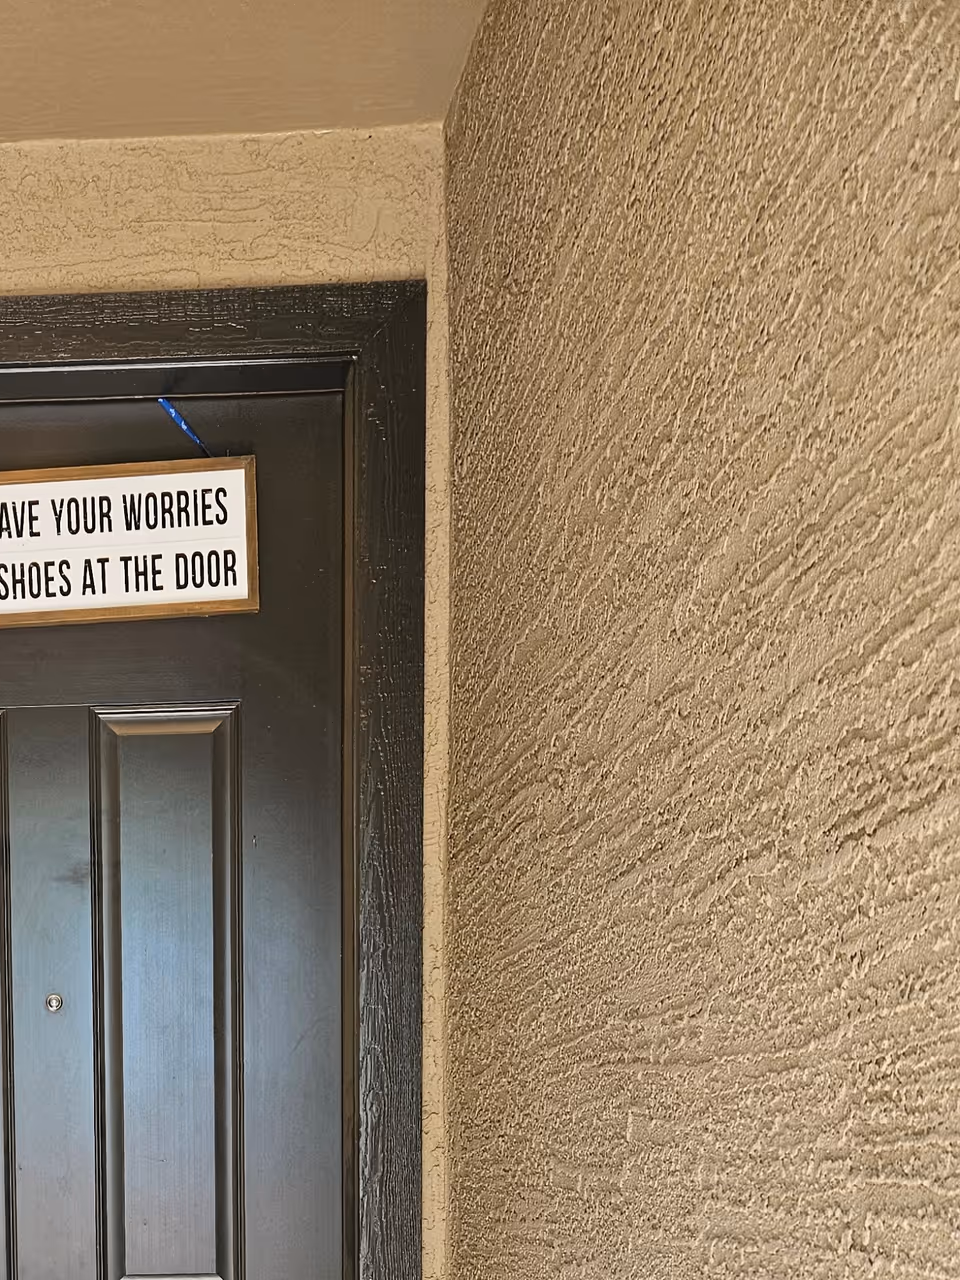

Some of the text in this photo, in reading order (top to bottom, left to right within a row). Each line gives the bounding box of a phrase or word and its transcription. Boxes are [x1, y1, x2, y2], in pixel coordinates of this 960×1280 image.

[50, 495, 113, 536] YOUR
[121, 487, 228, 532] WORRIES
[82, 558, 110, 597] AT
[120, 553, 164, 594] THE
[175, 549, 237, 591] DOOR
